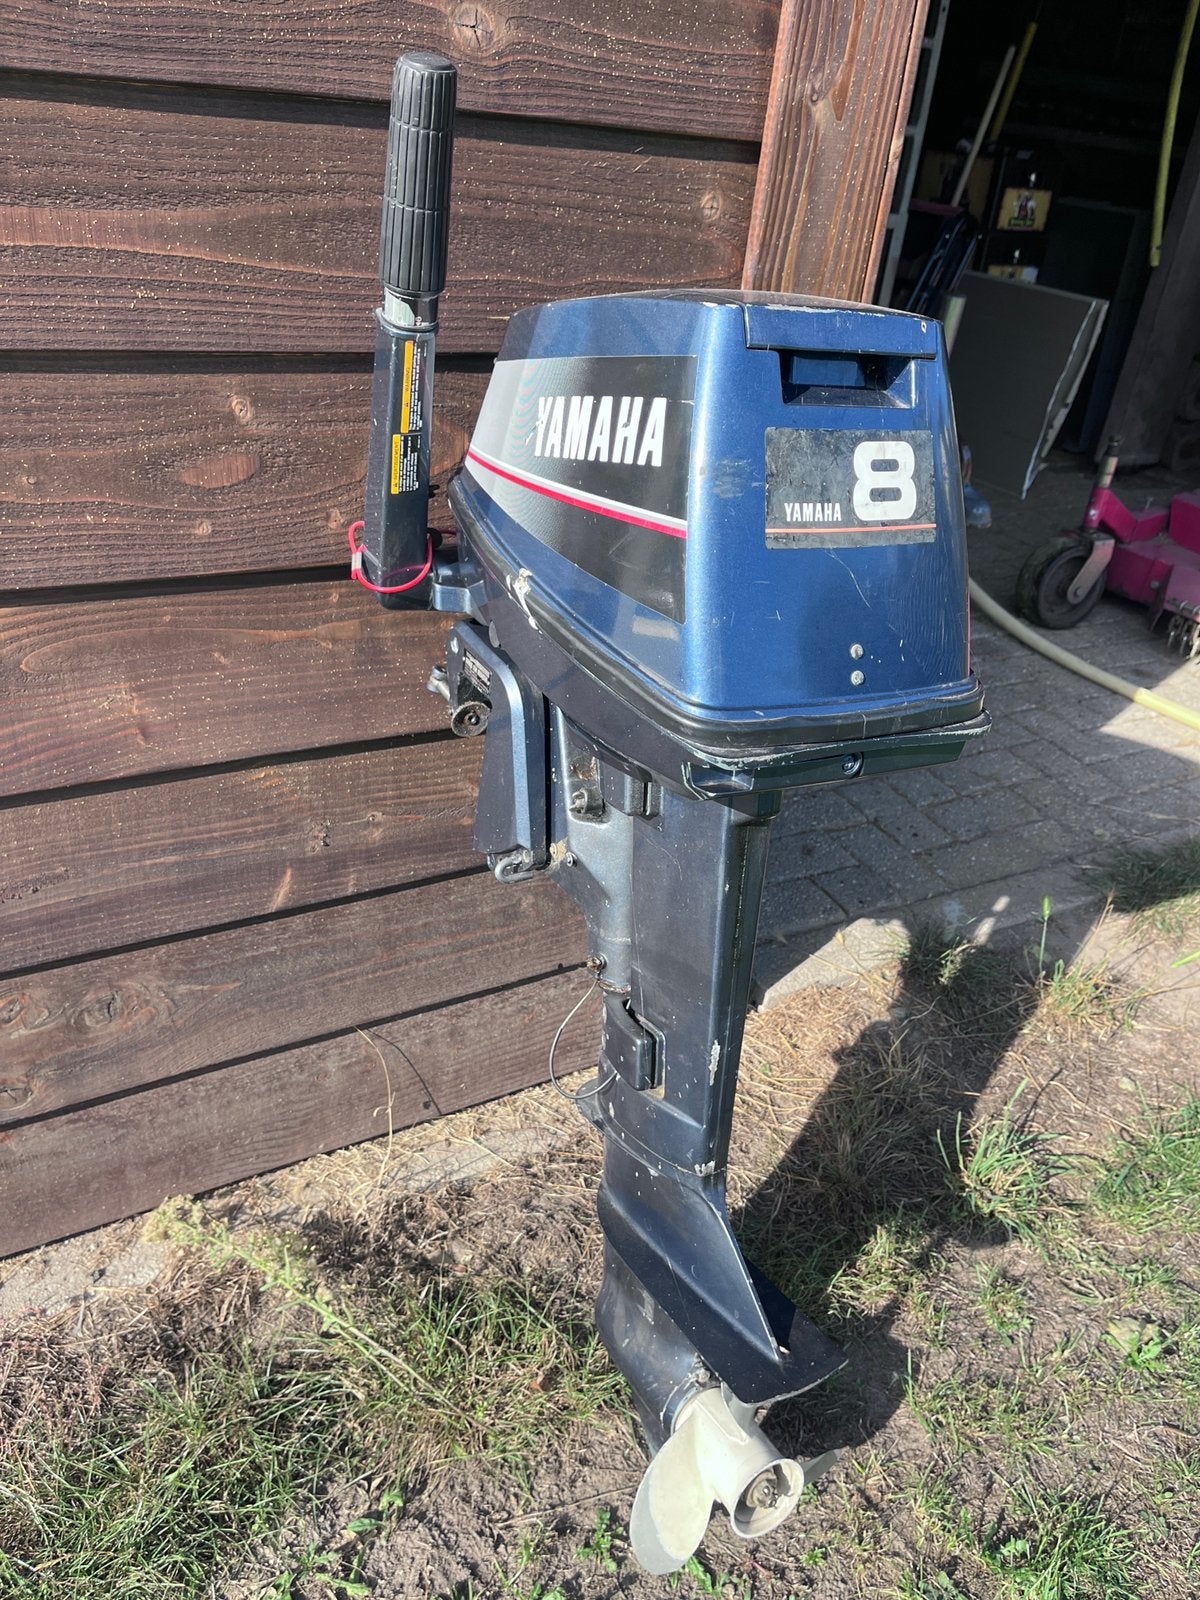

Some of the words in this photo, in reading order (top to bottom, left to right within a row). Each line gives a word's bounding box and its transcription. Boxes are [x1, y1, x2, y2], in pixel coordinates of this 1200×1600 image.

[535, 395, 667, 467] YAMAHA
[784, 502, 842, 522] YAMAHA
[853, 441, 917, 521] 8
